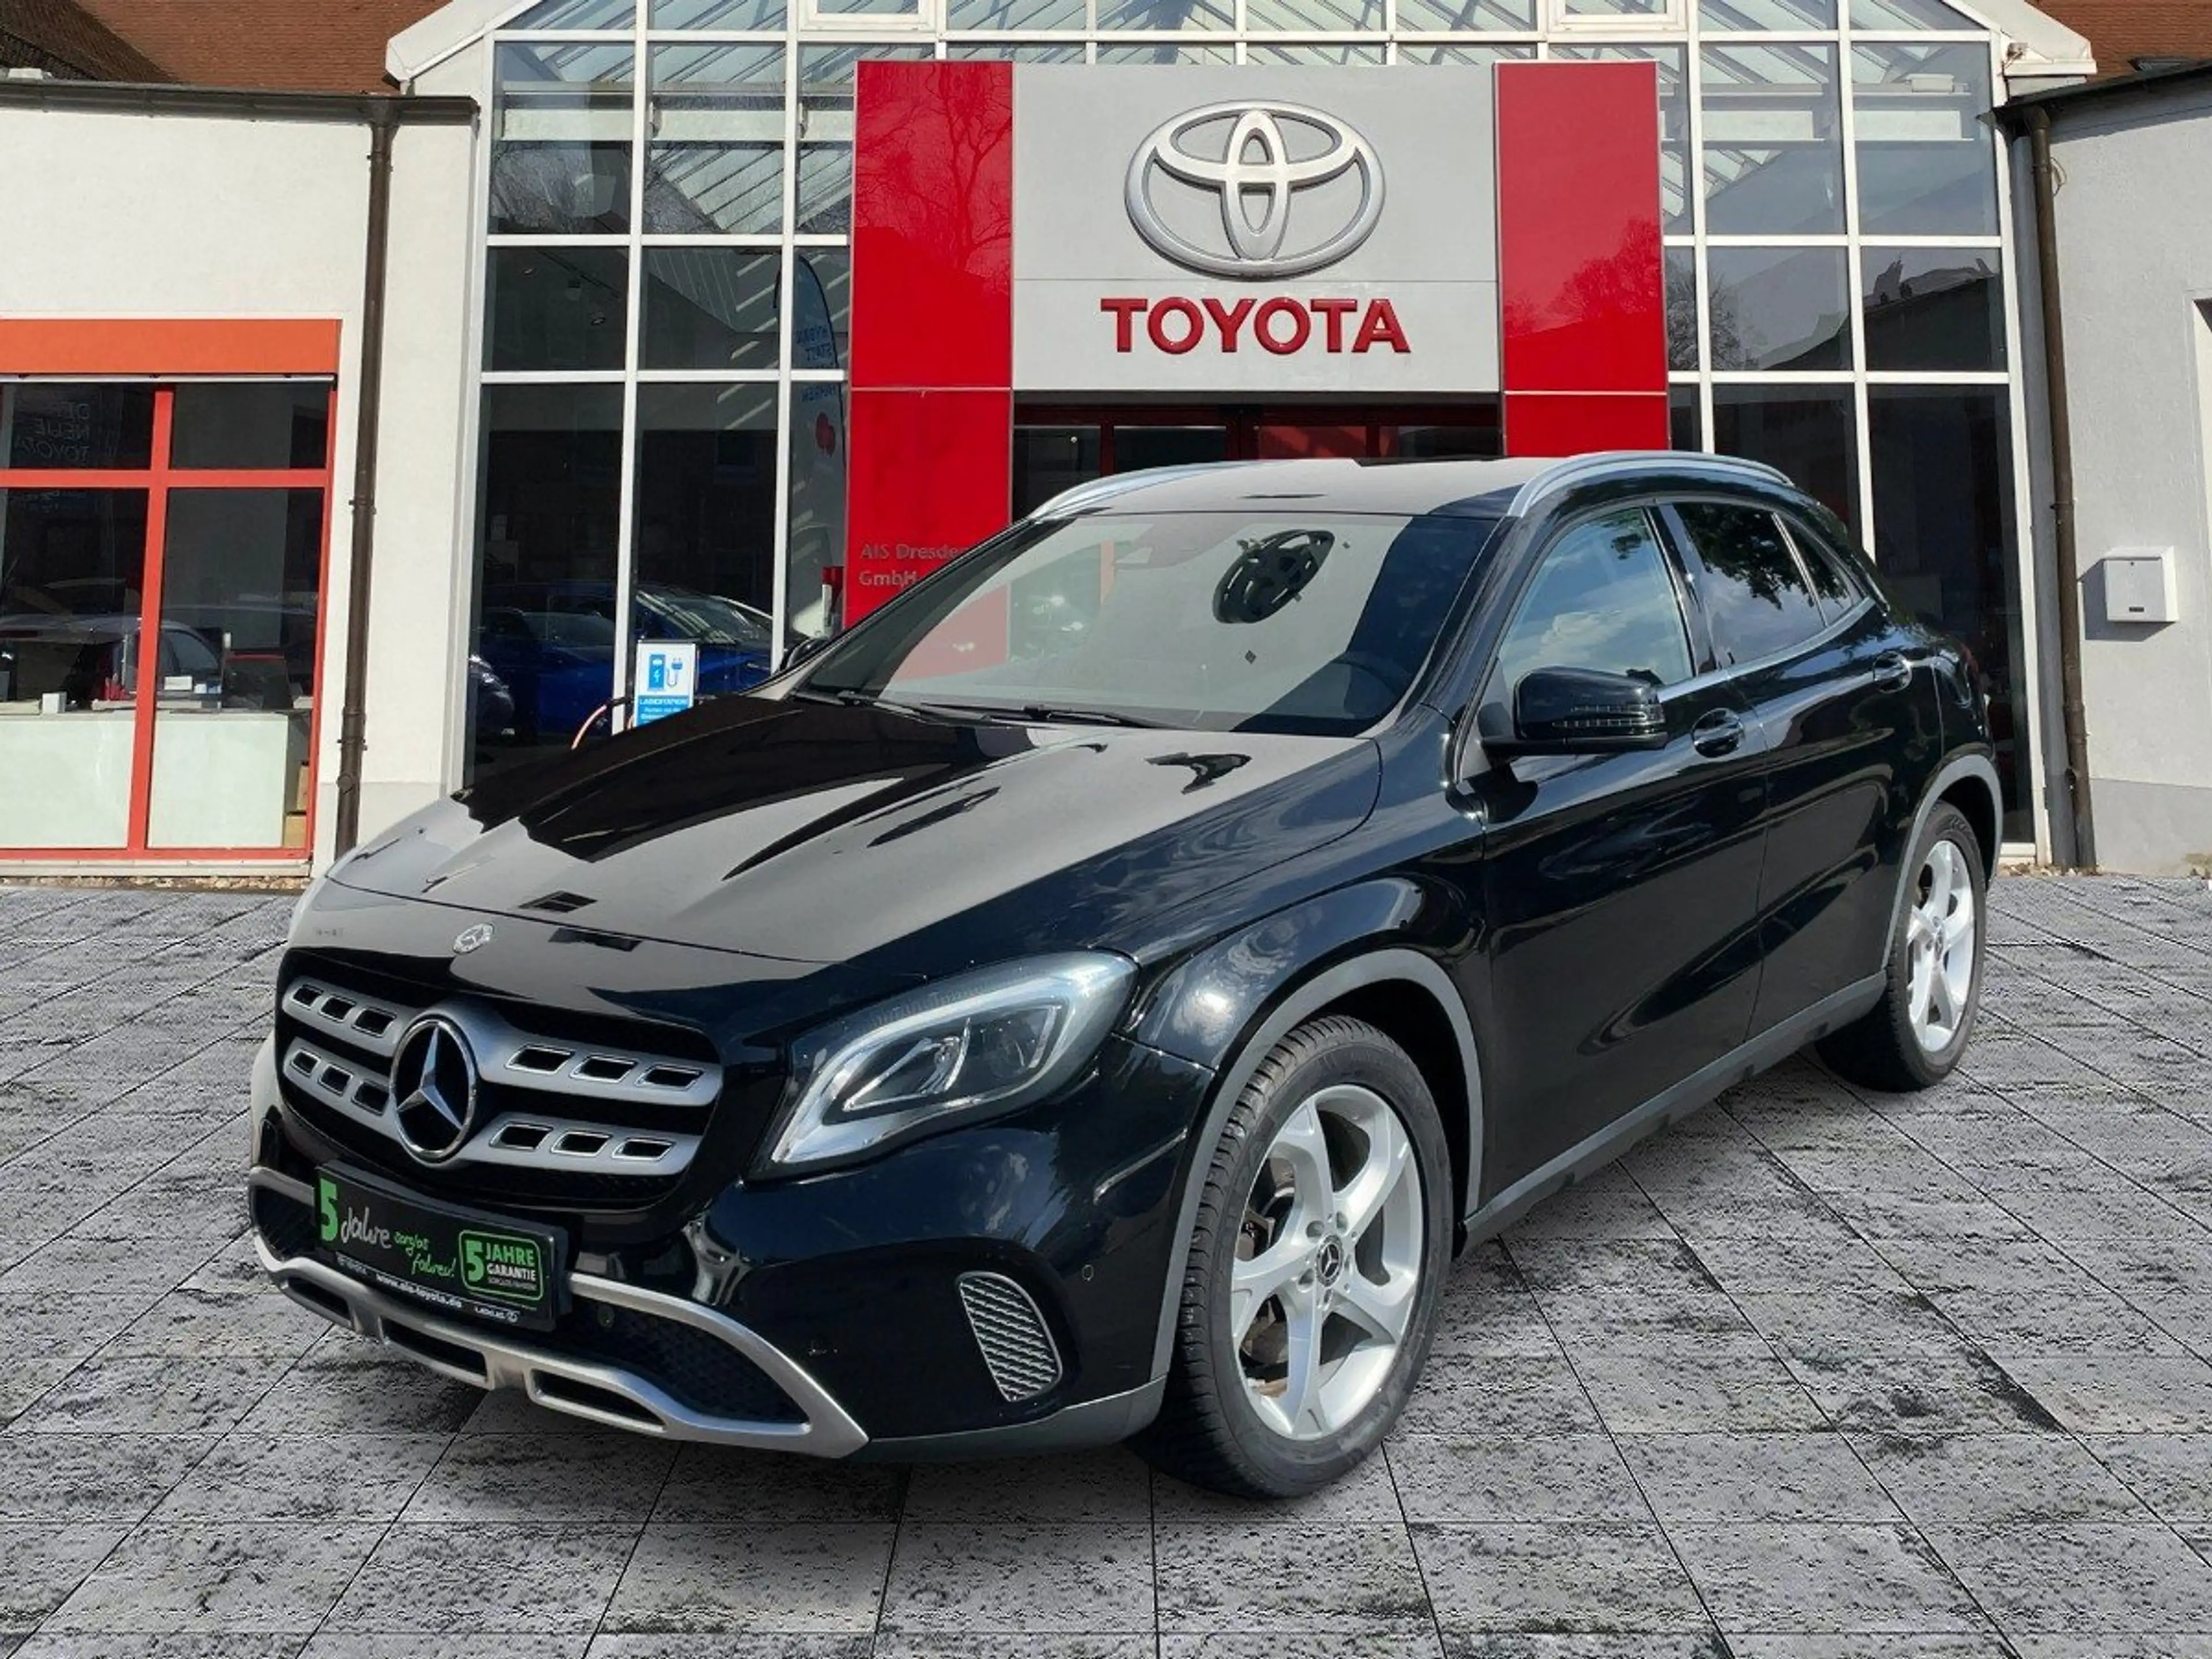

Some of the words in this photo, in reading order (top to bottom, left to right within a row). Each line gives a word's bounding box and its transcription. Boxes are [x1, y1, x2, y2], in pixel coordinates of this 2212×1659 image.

[1100, 297, 1411, 355] TOYOTA
[860, 544, 889, 559] AIS
[896, 543, 964, 559] Dresde
[859, 570, 918, 586] GmbH
[320, 1177, 338, 1241] 5
[340, 1206, 392, 1249] Jahre
[465, 1240, 484, 1282] 5
[485, 1242, 535, 1266] JAHRE
[486, 1263, 536, 1282] GARANTIE
